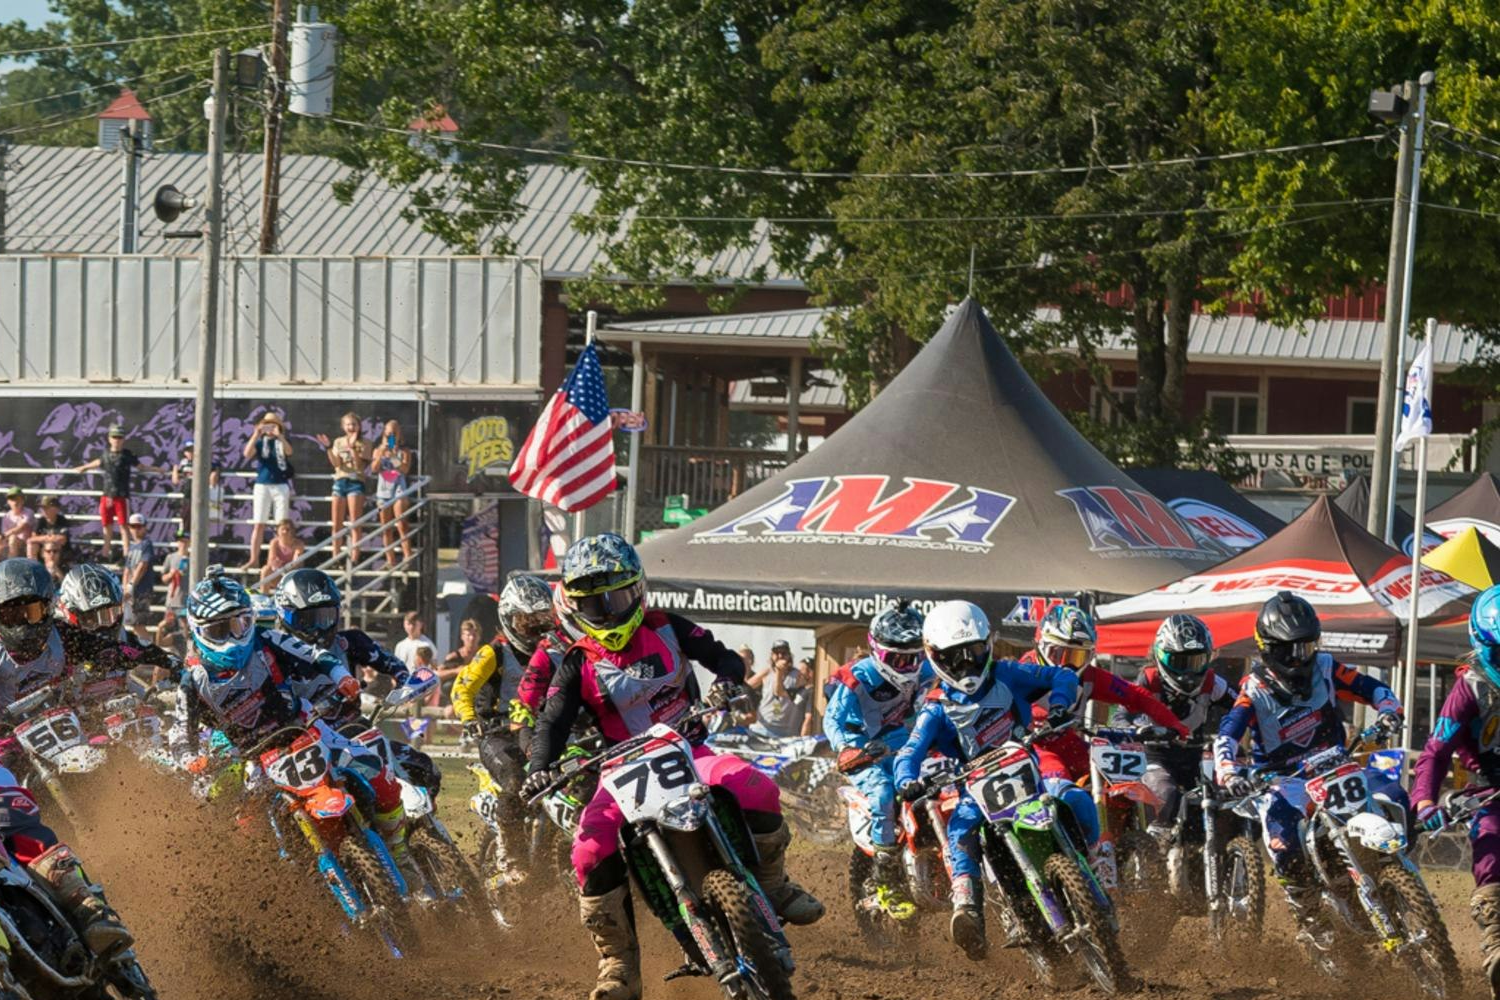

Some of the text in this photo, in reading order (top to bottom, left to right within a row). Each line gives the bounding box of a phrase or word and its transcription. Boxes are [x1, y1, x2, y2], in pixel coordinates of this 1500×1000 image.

[459, 416, 508, 463] MOTO
[466, 440, 513, 480] TEES
[1341, 454, 1374, 468] POL
[694, 474, 1018, 546] AMA
[688, 535, 990, 554] AMERICAN MOTORCYCLIST ASSOCIATION
[1211, 574, 1361, 593] WISECO
[26, 715, 79, 753] 56
[278, 744, 327, 789] 13
[613, 751, 695, 810] 78
[1101, 752, 1142, 776] 32
[982, 762, 1038, 814] 61
[1324, 776, 1368, 810] 48
